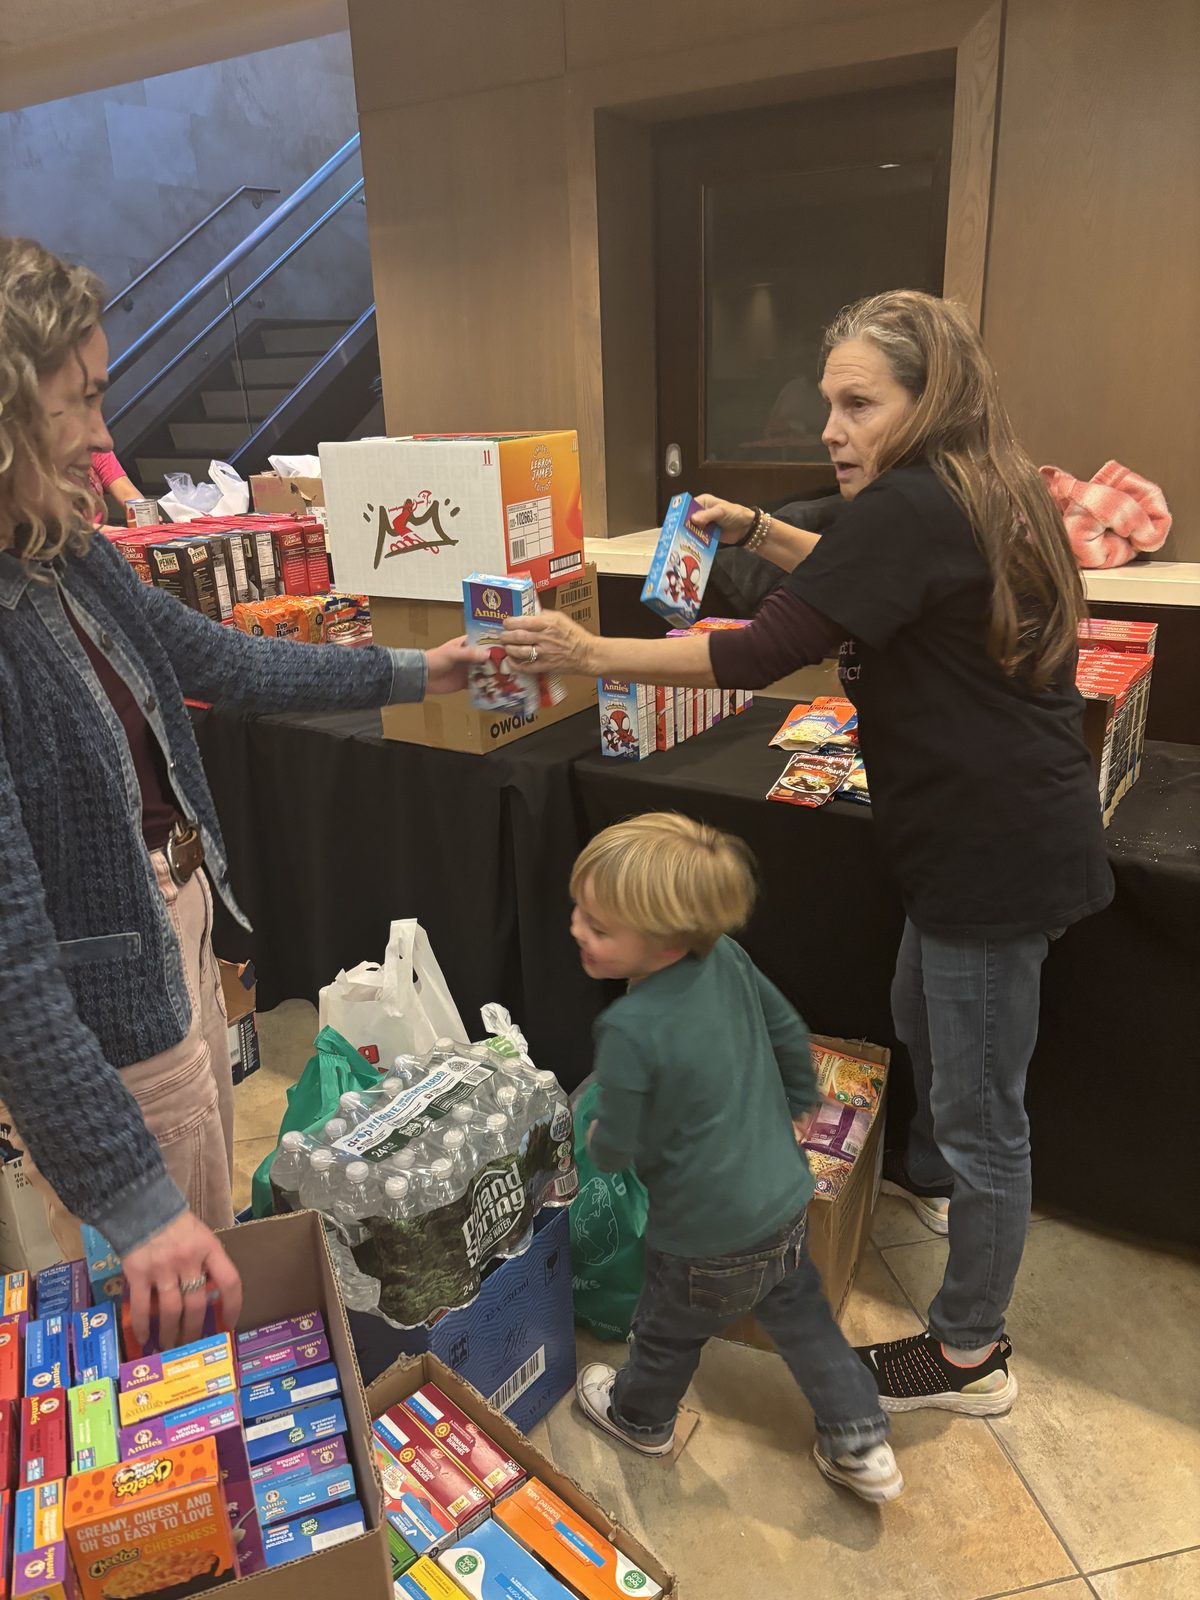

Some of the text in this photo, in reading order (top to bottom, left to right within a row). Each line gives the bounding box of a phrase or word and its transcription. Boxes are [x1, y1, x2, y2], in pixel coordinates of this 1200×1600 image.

[159, 555, 176, 567] PENNE
[604, 683, 629, 692] Annie's
[462, 1162, 523, 1247] Poland
[467, 1188, 526, 1269] Spring
[493, 1217, 512, 1238] WATER
[463, 1280, 474, 1297] 24
[81, 1312, 91, 1339] Annie's
[291, 1311, 318, 1323] Annie's
[296, 1339, 322, 1351] Annie's
[126, 1373, 159, 1388] Annie's
[31, 1396, 40, 1425] Annie's
[171, 1426, 205, 1442] CHEDDAR
[176, 1423, 198, 1434] WHITE
[127, 1438, 162, 1456] Annie's
[311, 1441, 340, 1456] Annie's
[446, 1436, 466, 1456] BUNCHES
[450, 1432, 471, 1454] CINNAMON
[276, 1452, 305, 1466] CHEDDAR
[116, 1458, 174, 1498] Cheetos
[411, 1461, 430, 1482] BUNCHES
[414, 1458, 436, 1480] CINNAMON
[261, 1498, 288, 1512] Annie's
[526, 1488, 561, 1520] toasted oats
[76, 1517, 132, 1541] CREAMY,
[134, 1502, 183, 1525] CHEESY,
[186, 1492, 212, 1511] AND
[80, 1536, 99, 1553] OH
[103, 1531, 120, 1547] SO
[124, 1522, 157, 1542] EASY
[161, 1516, 178, 1532] TO
[183, 1504, 214, 1524] LOVE
[269, 1529, 289, 1539] dinner
[266, 1534, 288, 1544] cheese
[266, 1537, 295, 1550] macaroni
[89, 1524, 217, 1579] Cheetos CHEESINESS
[45, 1546, 55, 1579] Annie's
